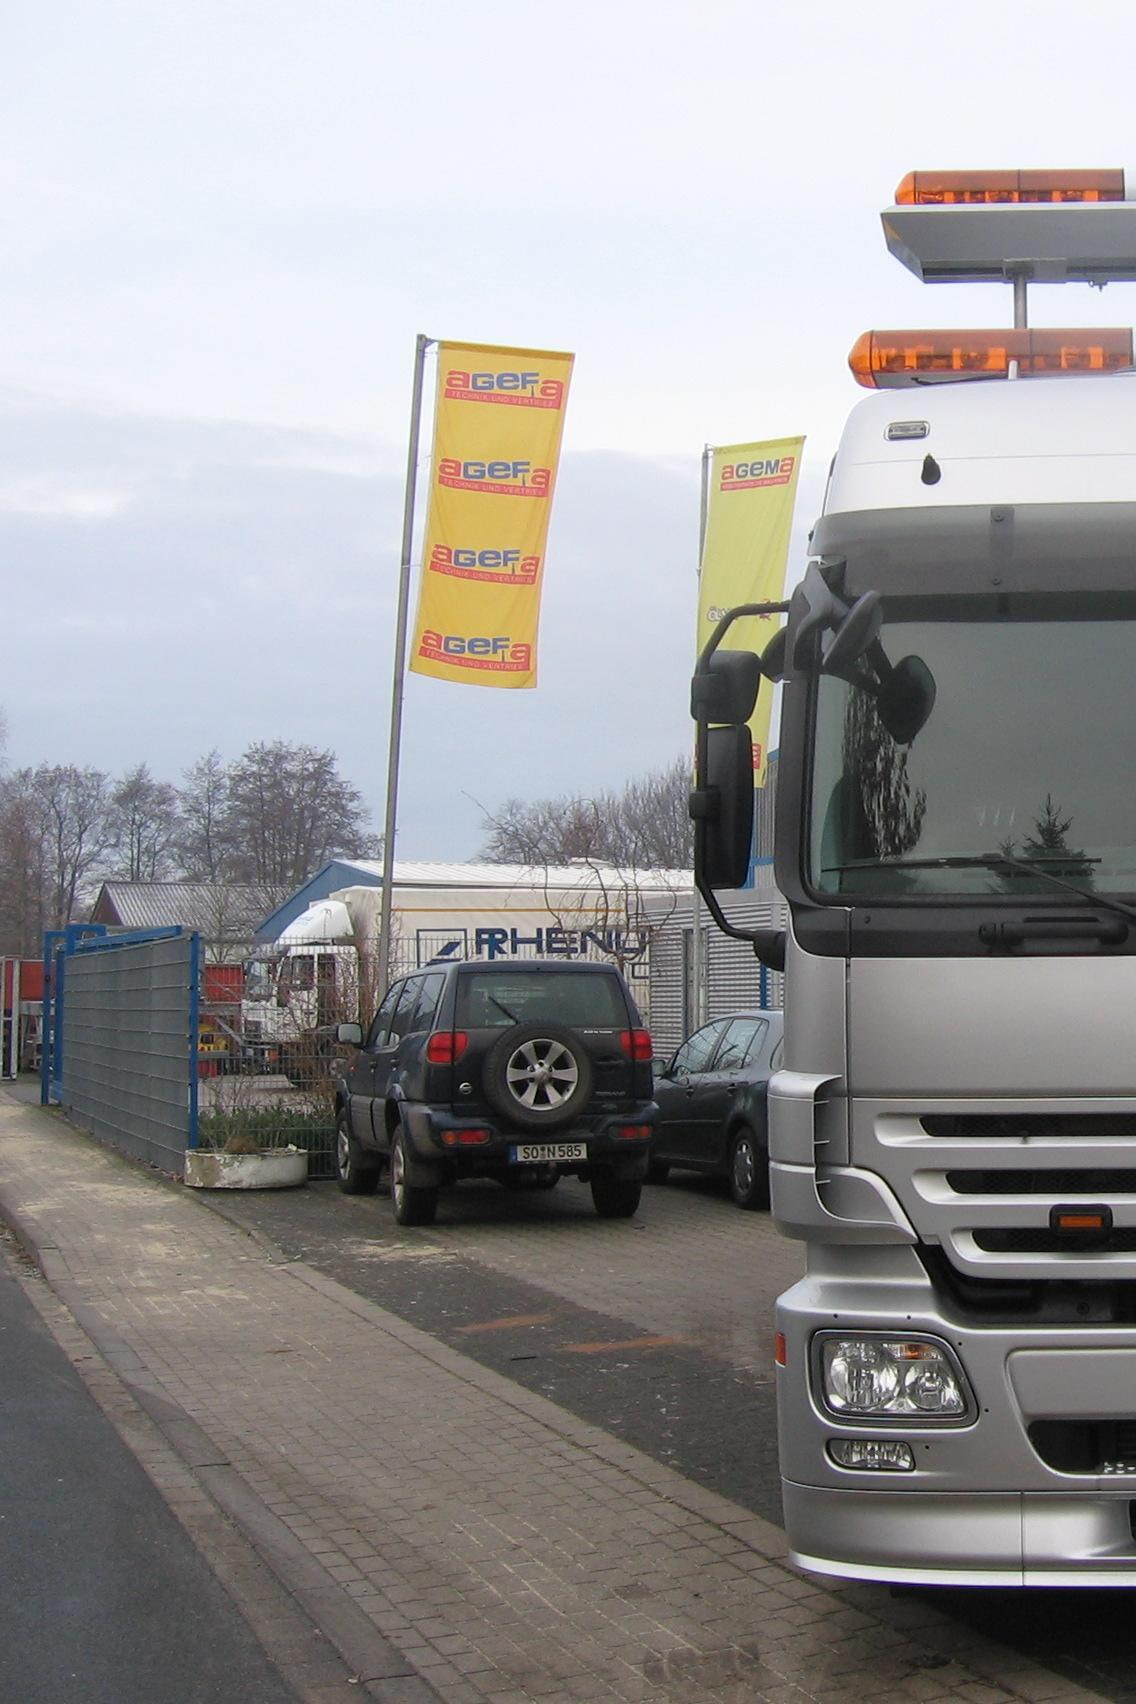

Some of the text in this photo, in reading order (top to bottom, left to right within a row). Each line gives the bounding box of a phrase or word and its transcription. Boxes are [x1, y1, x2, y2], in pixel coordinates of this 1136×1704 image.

[523, 1145, 582, 1160] SO N 585
